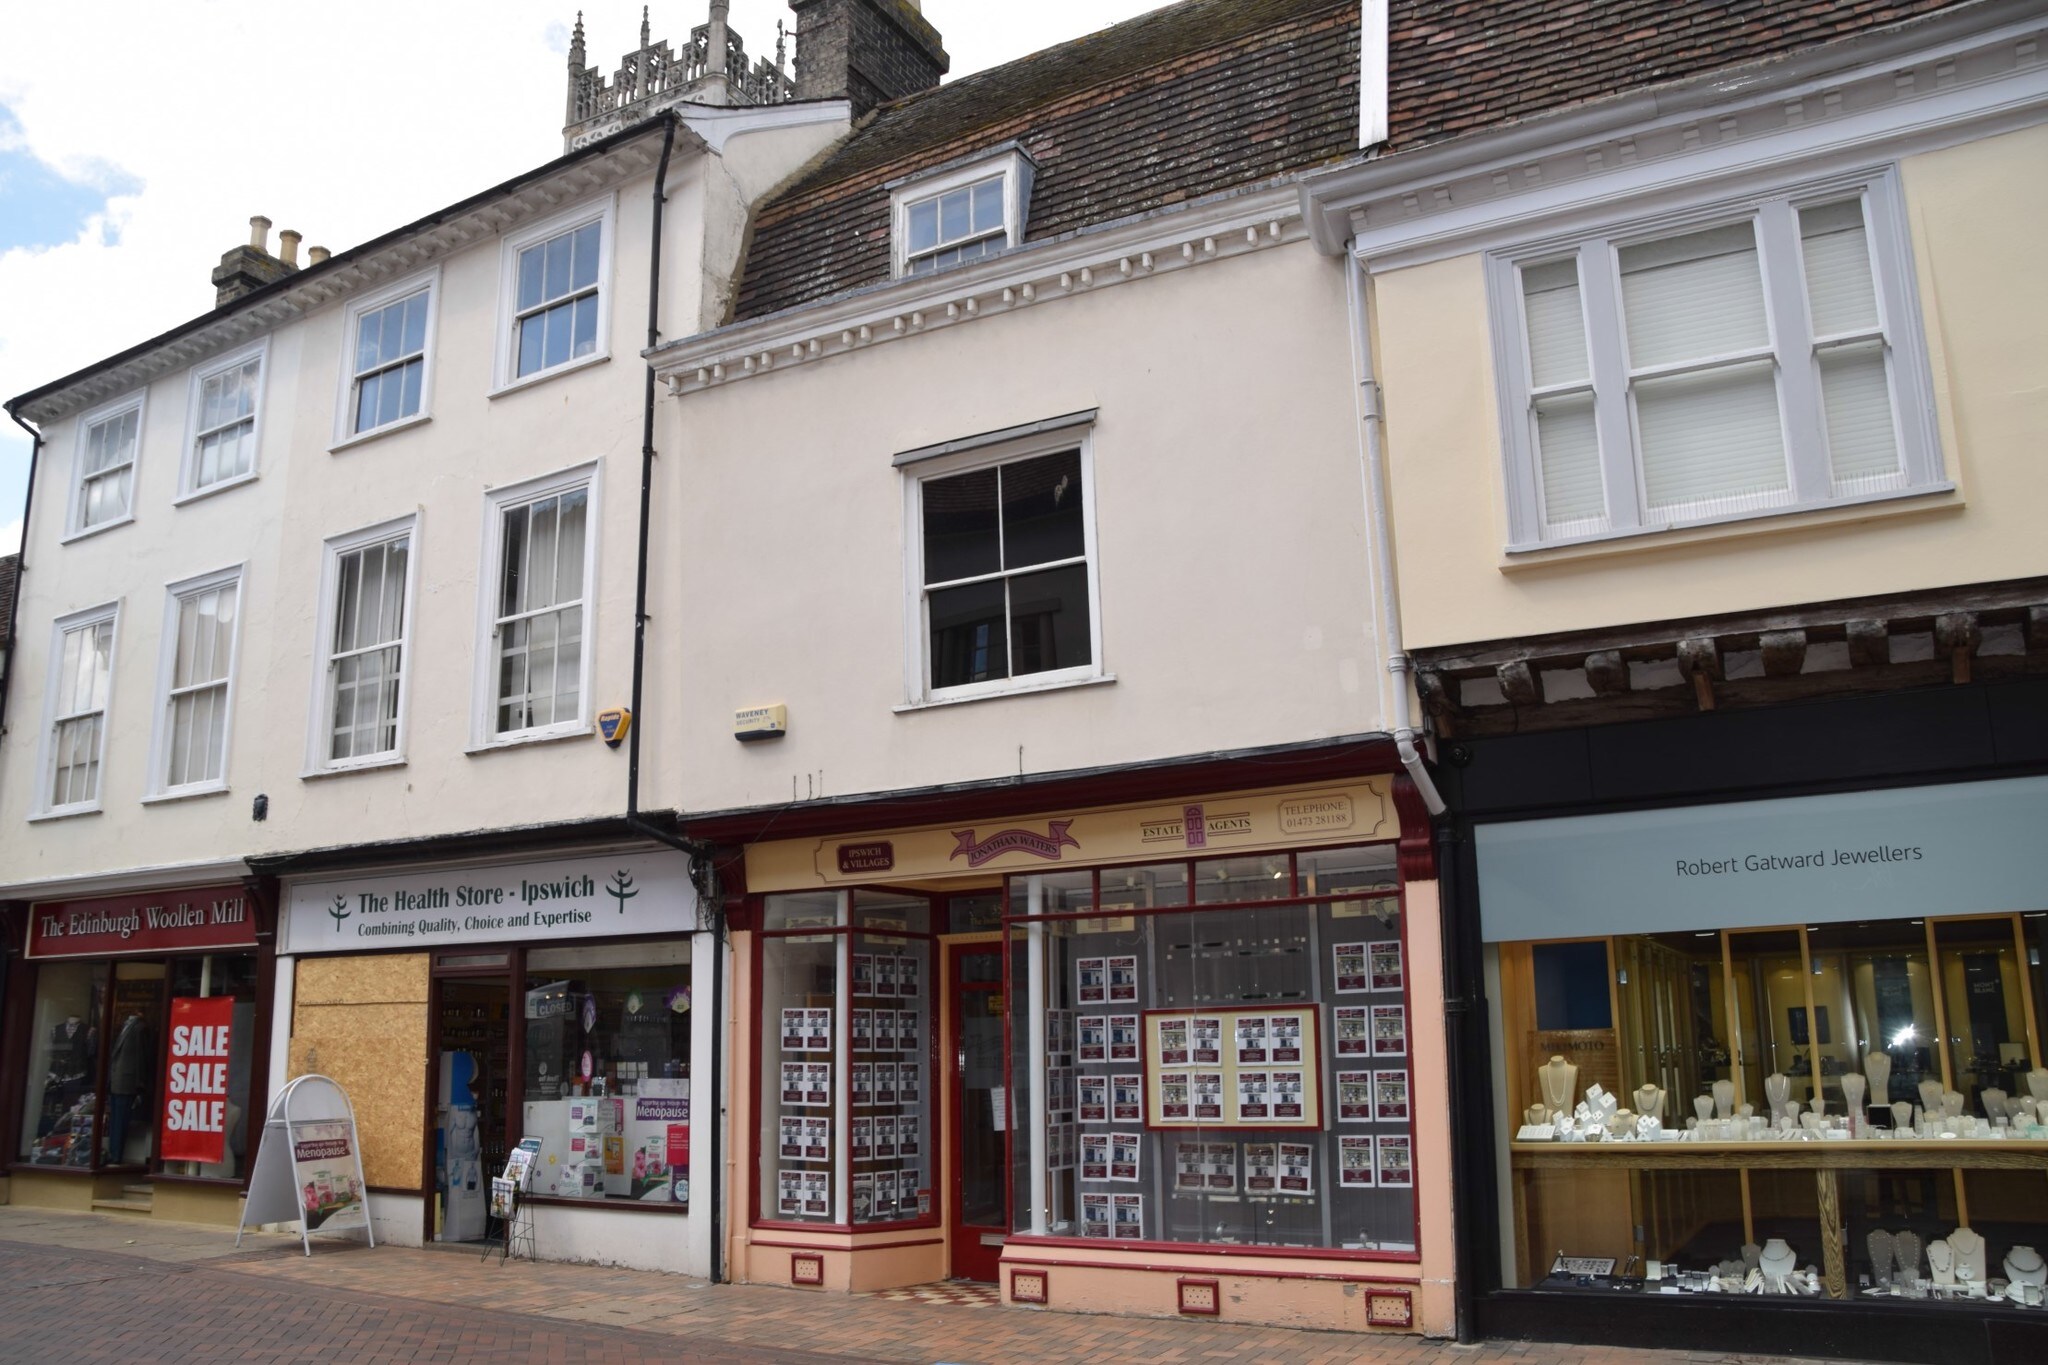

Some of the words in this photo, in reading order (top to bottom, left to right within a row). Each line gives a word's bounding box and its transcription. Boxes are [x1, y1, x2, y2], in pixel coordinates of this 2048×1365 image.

[736, 708, 769, 719] WAVENEY
[736, 717, 760, 726] SECURITY
[1208, 818, 1251, 831] AGENTS
[1286, 816, 1313, 828] 01473
[1315, 814, 1347, 825] 281188
[1143, 825, 1183, 837] ESTATE
[848, 847, 882, 858] IPSWICH
[970, 835, 1018, 862] JONATHAN
[1020, 836, 1058, 854] WATERS
[842, 861, 849, 869] &
[850, 857, 890, 868] VILLAGES
[1676, 858, 1738, 876] Robert
[1744, 850, 1825, 872] Gatward
[1831, 845, 1923, 866] Jewellers
[358, 893, 388, 914] The
[394, 887, 449, 911] Health
[456, 885, 504, 907] Store
[522, 874, 595, 906] Ipswich
[41, 916, 64, 938] The
[68, 908, 140, 939] Edinburgh
[146, 903, 205, 930] Woollen
[210, 898, 245, 924] Mill
[358, 921, 415, 937] Combining
[418, 918, 460, 935] Quality,
[464, 915, 504, 930] Choice
[507, 912, 530, 927] and
[534, 908, 592, 928] Expertise
[539, 1002, 572, 1016] CLOSED
[172, 1025, 229, 1057] SALE
[169, 1062, 227, 1094] SALE
[167, 1099, 224, 1132] SALE
[636, 1105, 688, 1120] Menopause
[296, 1146, 346, 1160] Menopause
